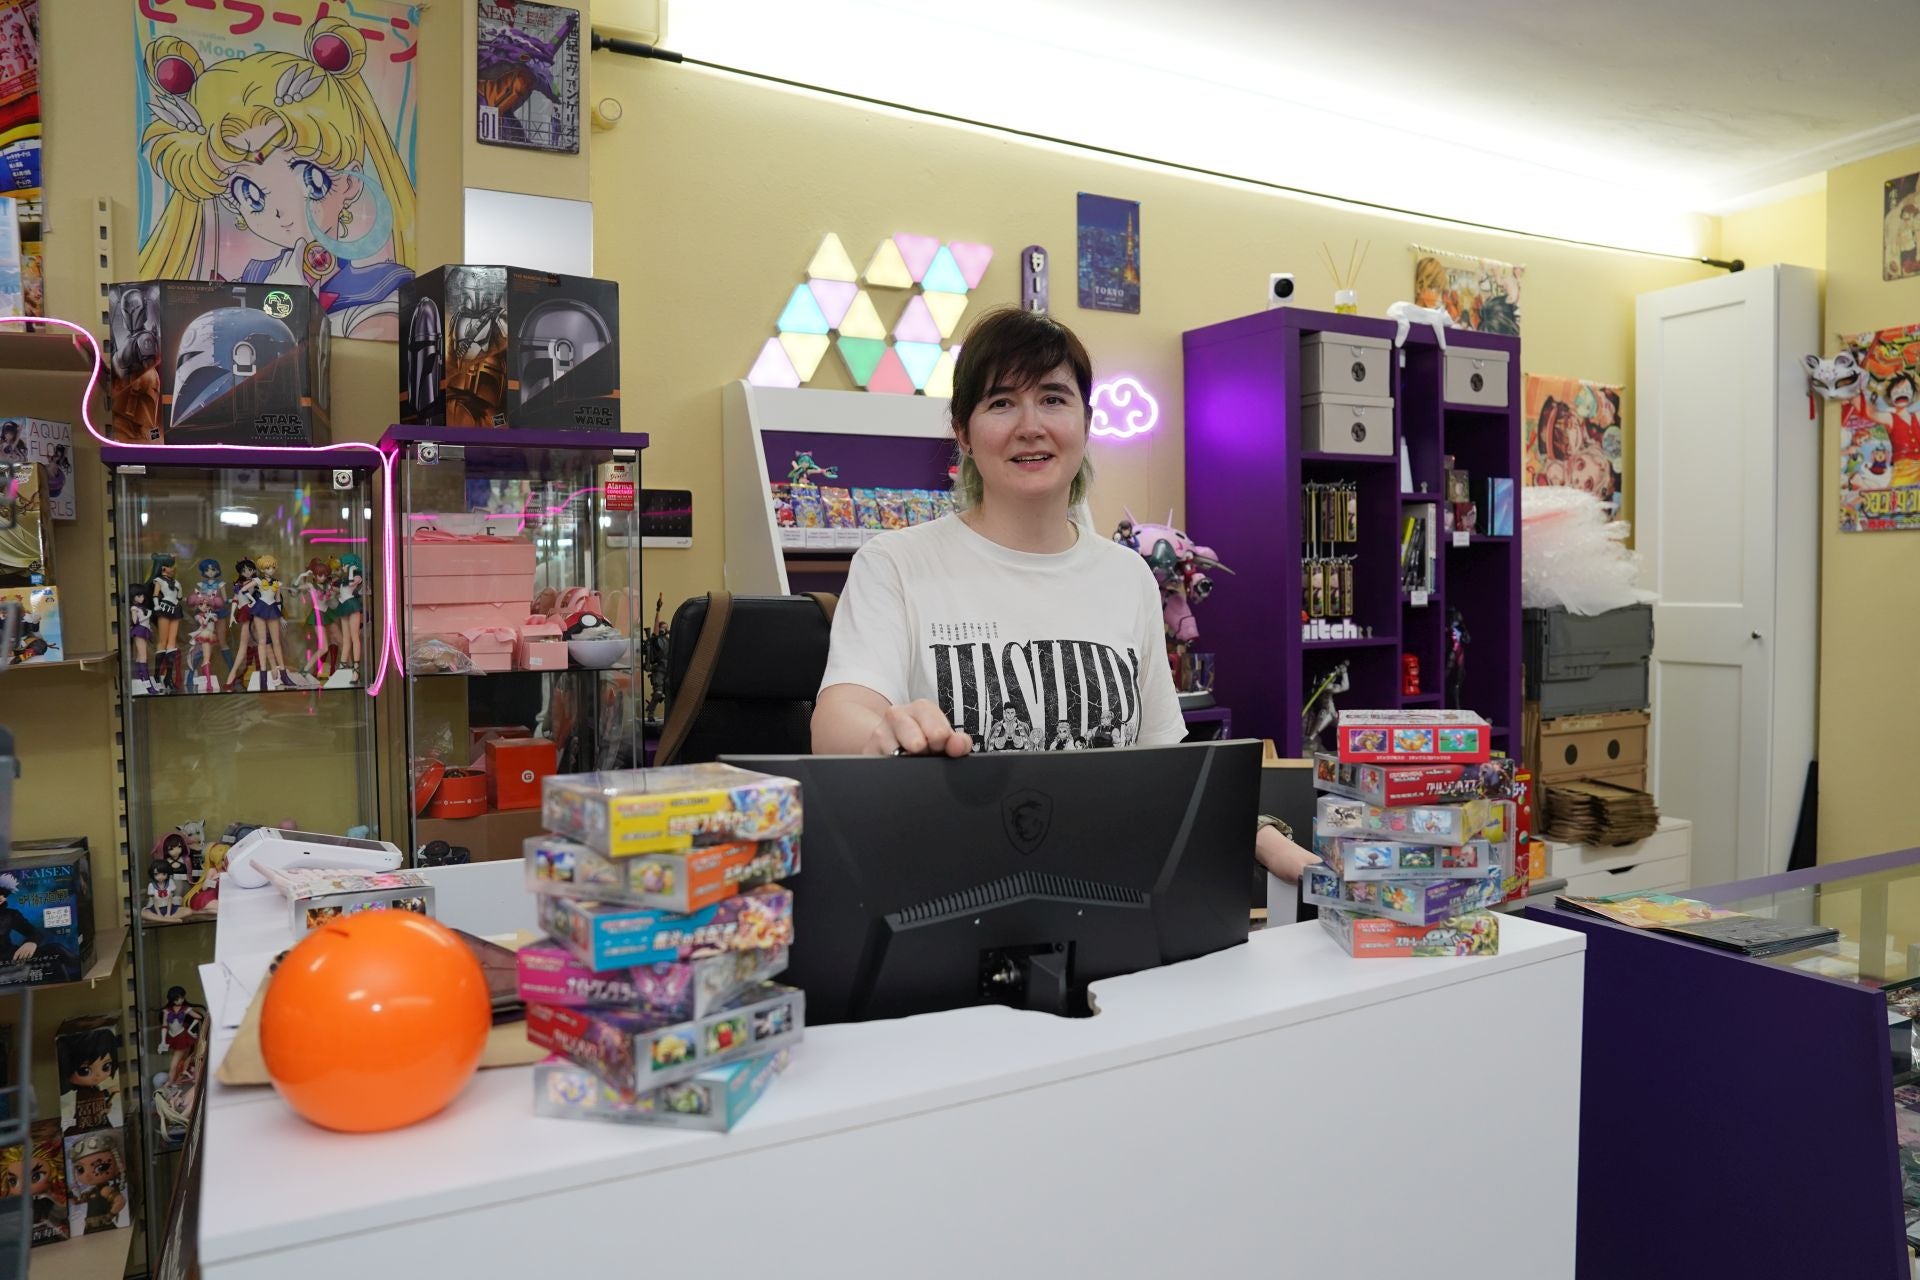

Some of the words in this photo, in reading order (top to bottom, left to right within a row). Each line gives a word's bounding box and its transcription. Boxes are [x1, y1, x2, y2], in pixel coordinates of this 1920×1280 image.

[198, 39, 246, 58] Moon
[480, 111, 498, 140] 01
[574, 406, 613, 416] STAR
[254, 414, 302, 425] STAR
[575, 416, 613, 426] WARS
[30, 421, 71, 441] AQUA
[255, 424, 303, 435] WARS
[1302, 619, 1357, 639] itch
[22, 866, 71, 880] KAISEN
